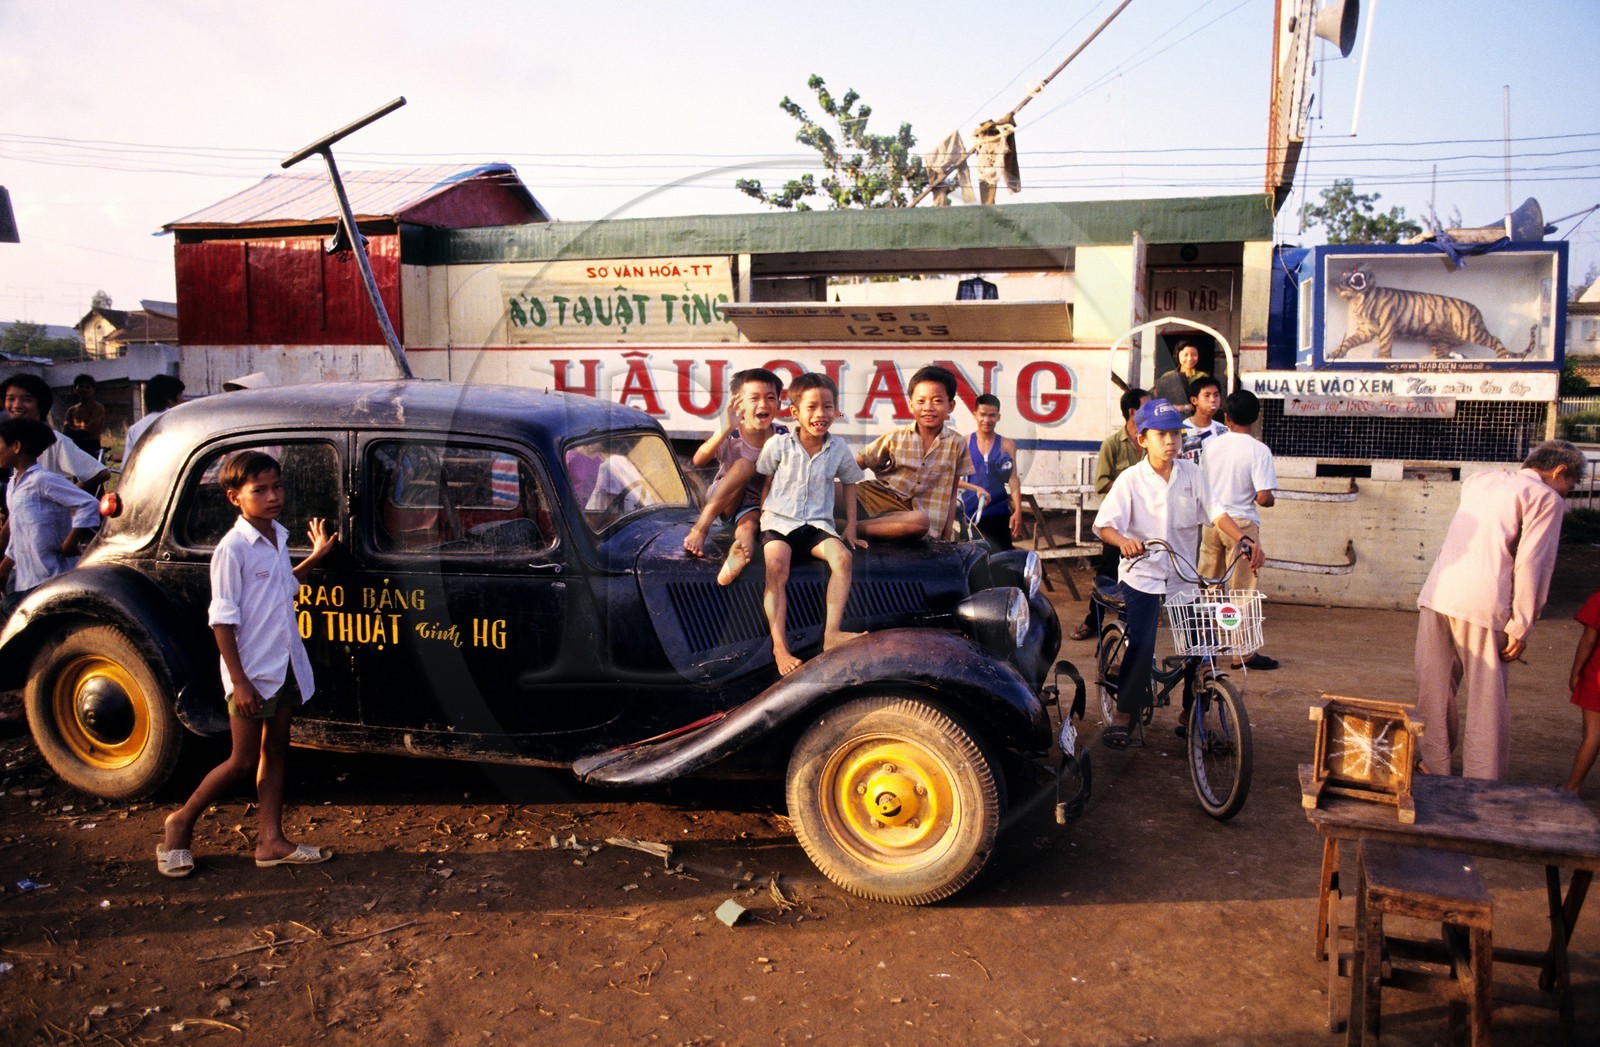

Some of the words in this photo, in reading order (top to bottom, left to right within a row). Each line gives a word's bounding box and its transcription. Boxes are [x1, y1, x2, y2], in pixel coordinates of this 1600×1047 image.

[1255, 379, 1290, 392] MUA
[1359, 379, 1393, 392] XEM
[299, 583, 344, 607] RAO
[322, 607, 402, 650] THUẬT
[473, 617, 507, 650] HG
